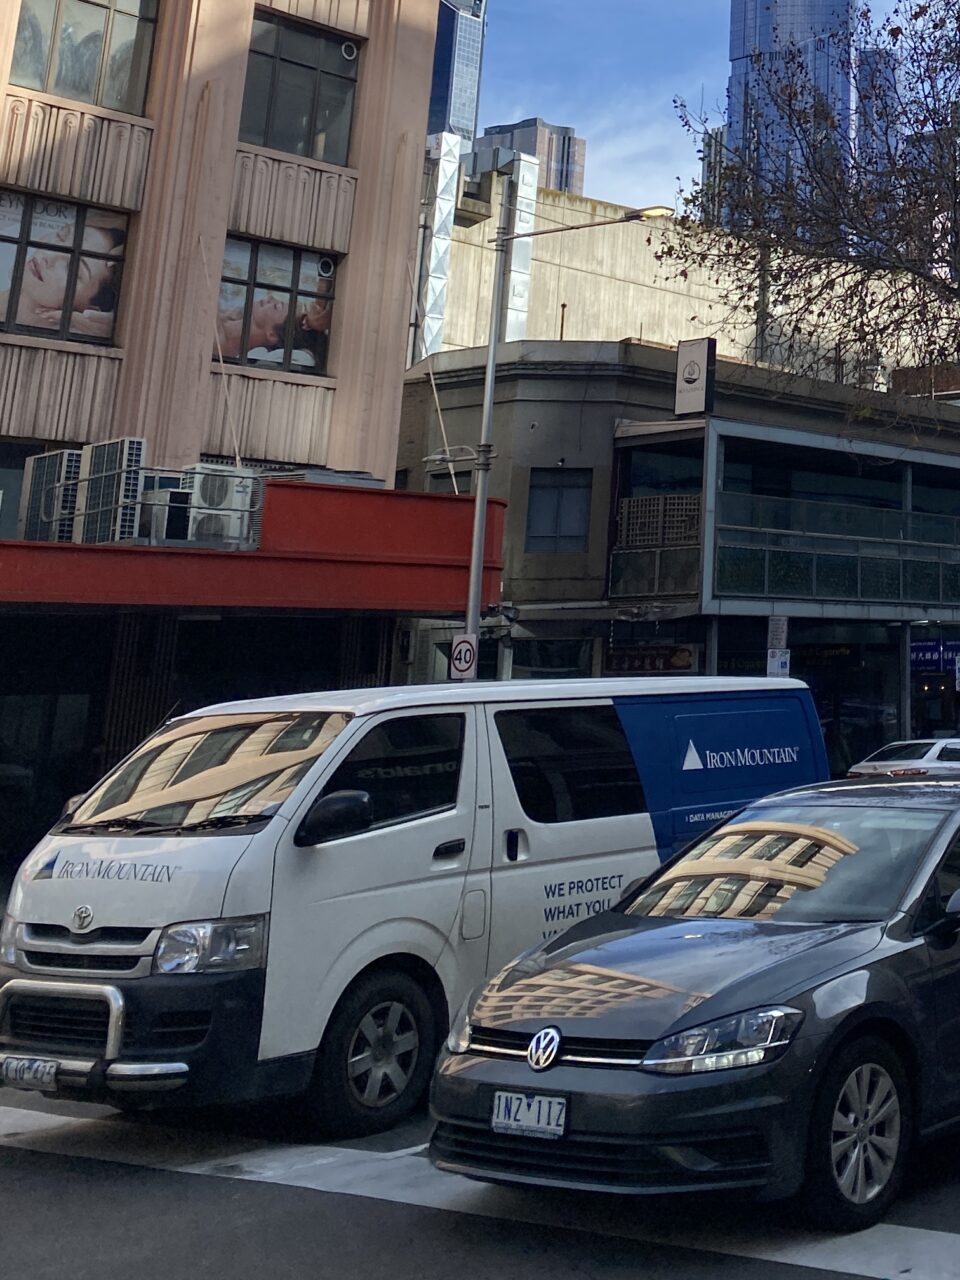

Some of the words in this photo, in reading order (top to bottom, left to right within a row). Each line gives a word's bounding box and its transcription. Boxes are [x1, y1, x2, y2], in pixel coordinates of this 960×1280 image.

[454, 648, 471, 664] 40
[689, 813, 704, 822] DATA
[544, 883, 564, 899] WE
[568, 874, 623, 896] PROTECT
[544, 903, 582, 922] WHAT
[585, 898, 611, 915] YOU
[496, 1095, 522, 1122] 1NZ
